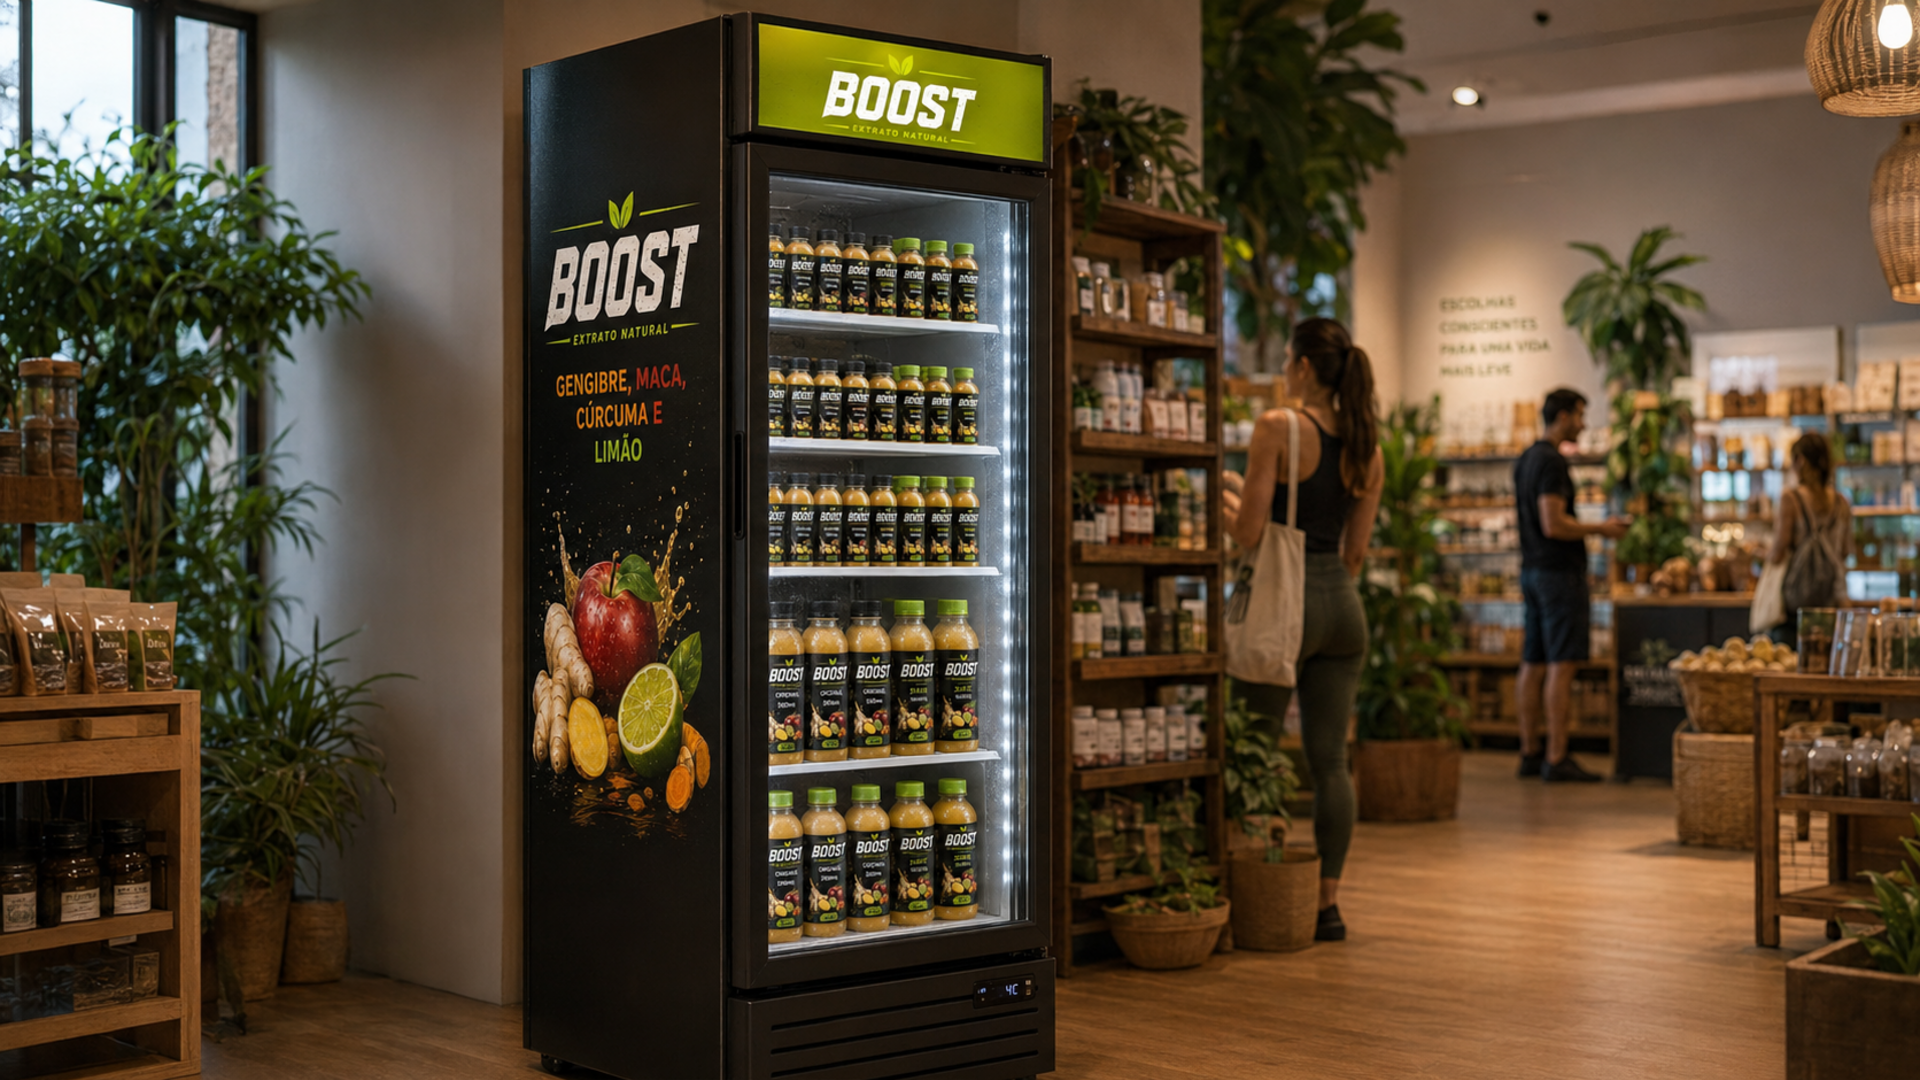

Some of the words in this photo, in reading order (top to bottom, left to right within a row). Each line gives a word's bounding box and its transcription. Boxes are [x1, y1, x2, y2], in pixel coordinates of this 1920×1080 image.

[822, 70, 977, 132] BOOST
[852, 124, 899, 138] EXTRATO
[903, 130, 949, 144] NATURAL
[544, 224, 700, 332] BOOST
[1440, 296, 1515, 312] ESCOLHAS
[573, 329, 617, 346] EXTRATO
[620, 323, 669, 340] NATURAL
[556, 369, 632, 398] GENGIBRE,
[636, 363, 687, 391] MACA,
[576, 400, 649, 430] CÚRCUMA
[653, 401, 663, 425] E
[595, 433, 643, 463] LIMÃO
[768, 667, 804, 683] BOOST
[813, 666, 847, 681] BOOST
[856, 664, 891, 679] BOOST
[900, 663, 935, 678] BOOST
[944, 662, 979, 676] BOOST
[855, 838, 890, 854] BOOST
[900, 835, 934, 851] BOOST
[944, 831, 977, 846] BOOST
[768, 846, 803, 862] BOOST
[811, 842, 846, 858] BOOST
